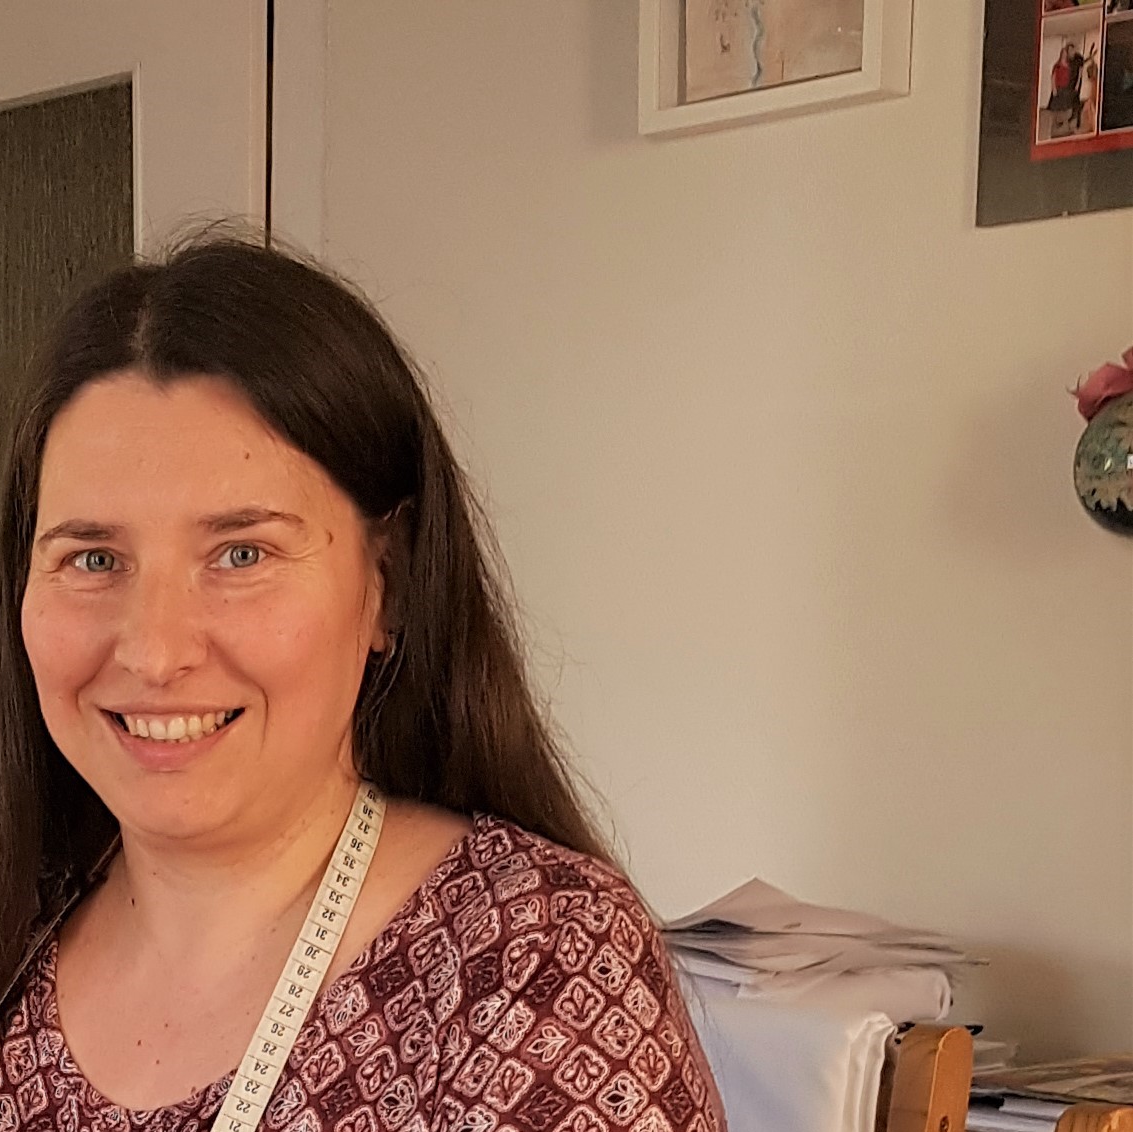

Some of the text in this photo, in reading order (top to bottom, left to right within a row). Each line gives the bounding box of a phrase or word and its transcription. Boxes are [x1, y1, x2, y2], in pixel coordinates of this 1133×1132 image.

[362, 806, 374, 819] 38
[357, 821, 370, 834] 37
[350, 838, 364, 851] 36
[342, 856, 356, 868] 35
[335, 874, 350, 887] 34
[328, 891, 343, 904] 33
[322, 909, 336, 922] 32
[315, 927, 328, 940] 31
[304, 947, 320, 960] 30
[297, 965, 312, 978] 29
[288, 985, 303, 998] 28
[279, 1004, 295, 1017] 27
[270, 1023, 285, 1036] 26
[261, 1043, 277, 1055] 25
[254, 1062, 269, 1075] 24
[244, 1081, 260, 1094] 23
[236, 1100, 251, 1113] 22
[228, 1120, 242, 1132] 21
